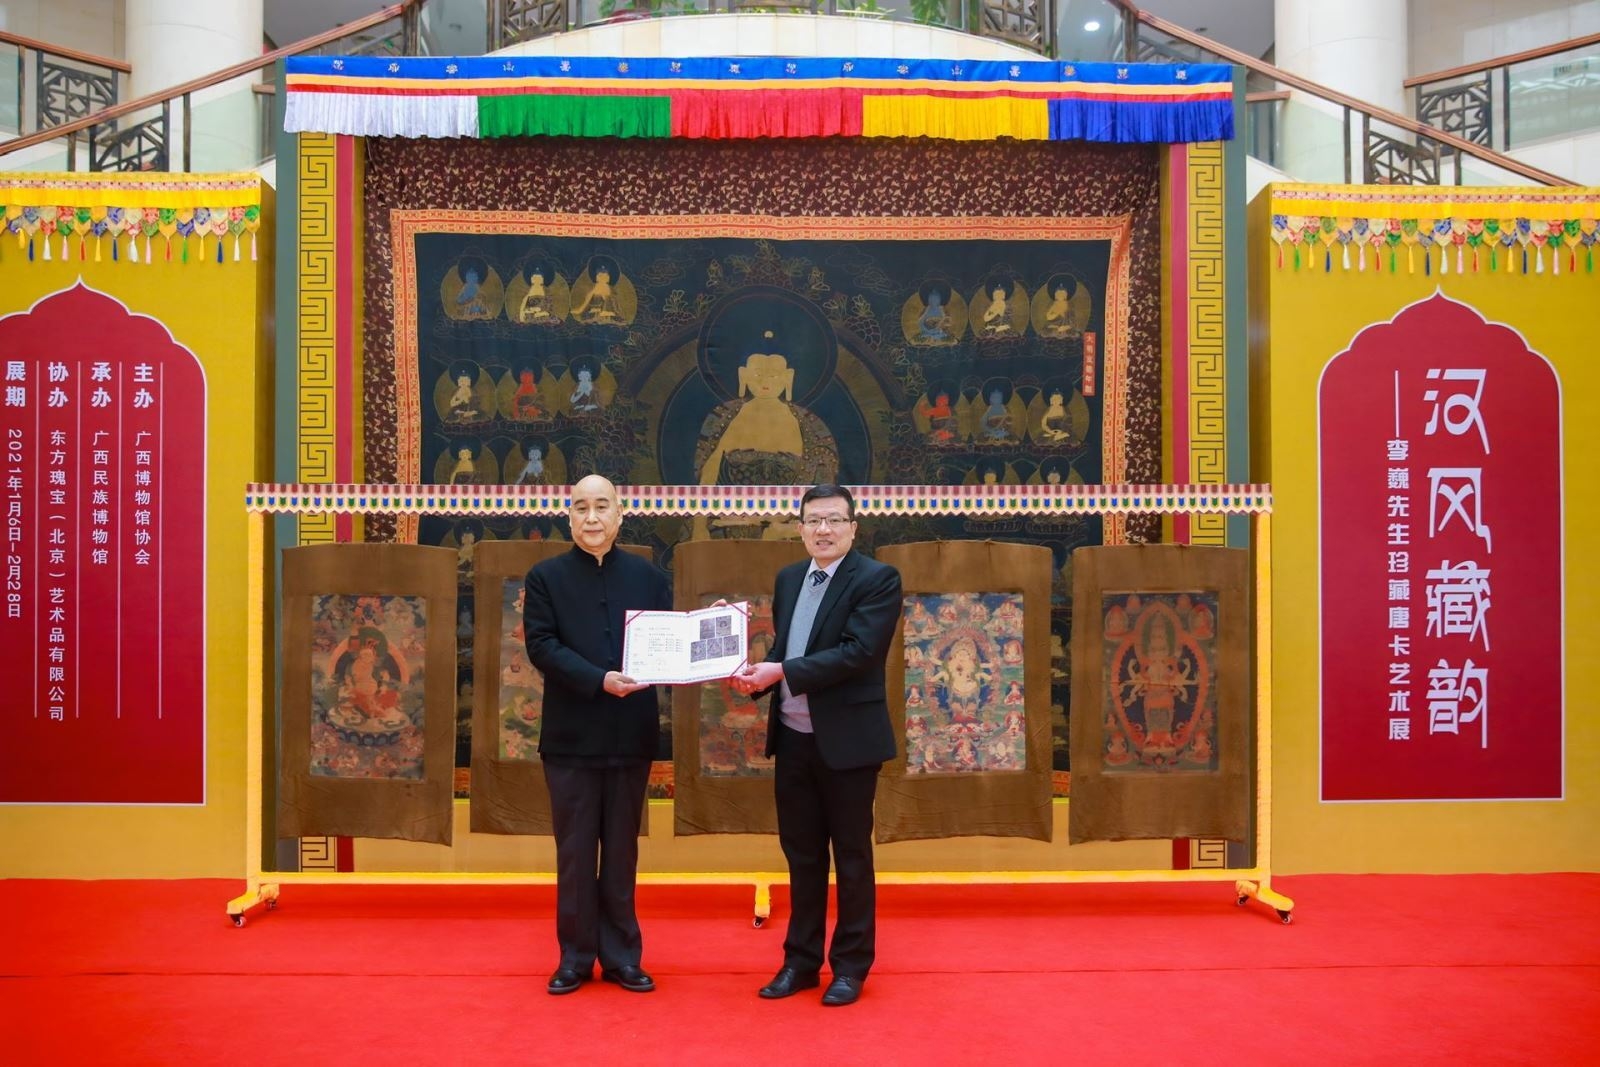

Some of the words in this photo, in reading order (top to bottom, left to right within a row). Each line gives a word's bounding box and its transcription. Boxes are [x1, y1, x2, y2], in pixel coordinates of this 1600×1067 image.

[5, 360, 26, 407] 展期
[47, 361, 69, 408] 协办
[91, 361, 112, 408] 承办
[133, 362, 154, 409] 主办
[92, 430, 109, 566] 广西民族博物馆
[133, 430, 152, 566] 广西博物馆协会
[48, 429, 66, 722] 东方瑰宝（北京）艺术品有限公司
[1423, 368, 1492, 749] 汉风藏韵
